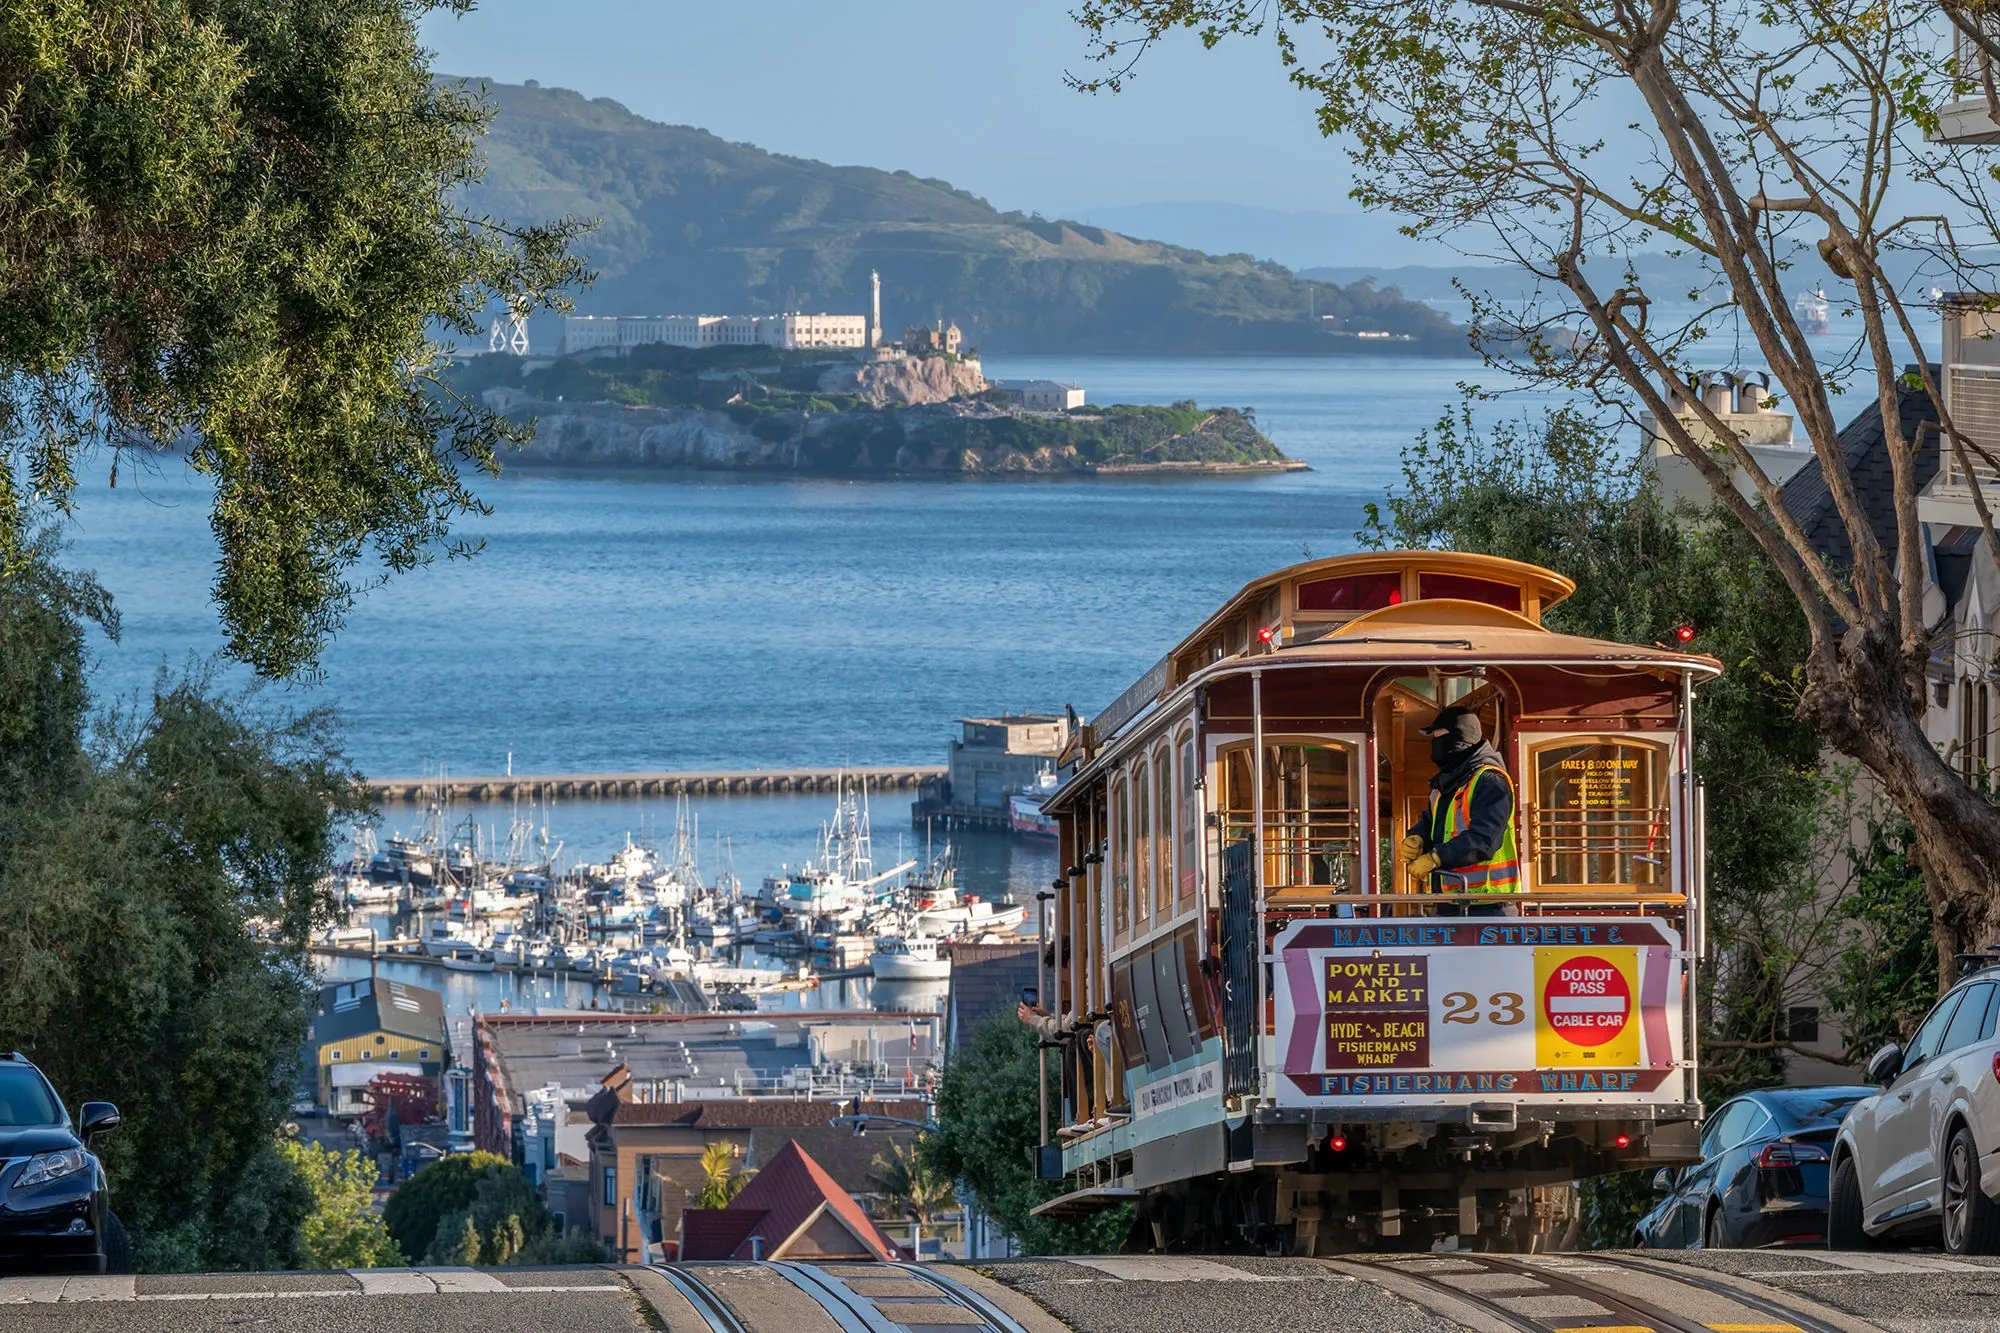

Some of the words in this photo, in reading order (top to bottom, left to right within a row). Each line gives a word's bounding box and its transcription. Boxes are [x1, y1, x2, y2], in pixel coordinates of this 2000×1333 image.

[1606, 760, 1621, 769] ONE
[1622, 760, 1638, 769] WAY
[1333, 927, 1456, 946] MARKET
[1480, 925, 1596, 945] STREET
[1330, 963, 1423, 977] POWELL
[1561, 969, 1582, 981] DO
[1584, 969, 1614, 981] NOT
[1354, 977, 1400, 988] AND
[1570, 982, 1605, 994] PASS
[1328, 989, 1424, 1003] MARKET
[1442, 992, 1525, 1025] 23
[1553, 1015, 1594, 1026] CABLE
[1597, 1015, 1623, 1026] CAR
[1330, 1023, 1363, 1038] HYDE
[1365, 1024, 1381, 1038] AND
[1383, 1022, 1425, 1038] BEACH
[1338, 1041, 1417, 1053] FISHERMANS
[1357, 1053, 1398, 1064] WHARF
[1320, 1074, 1517, 1095] FISHERMANS
[1540, 1072, 1638, 1092] WHARF
